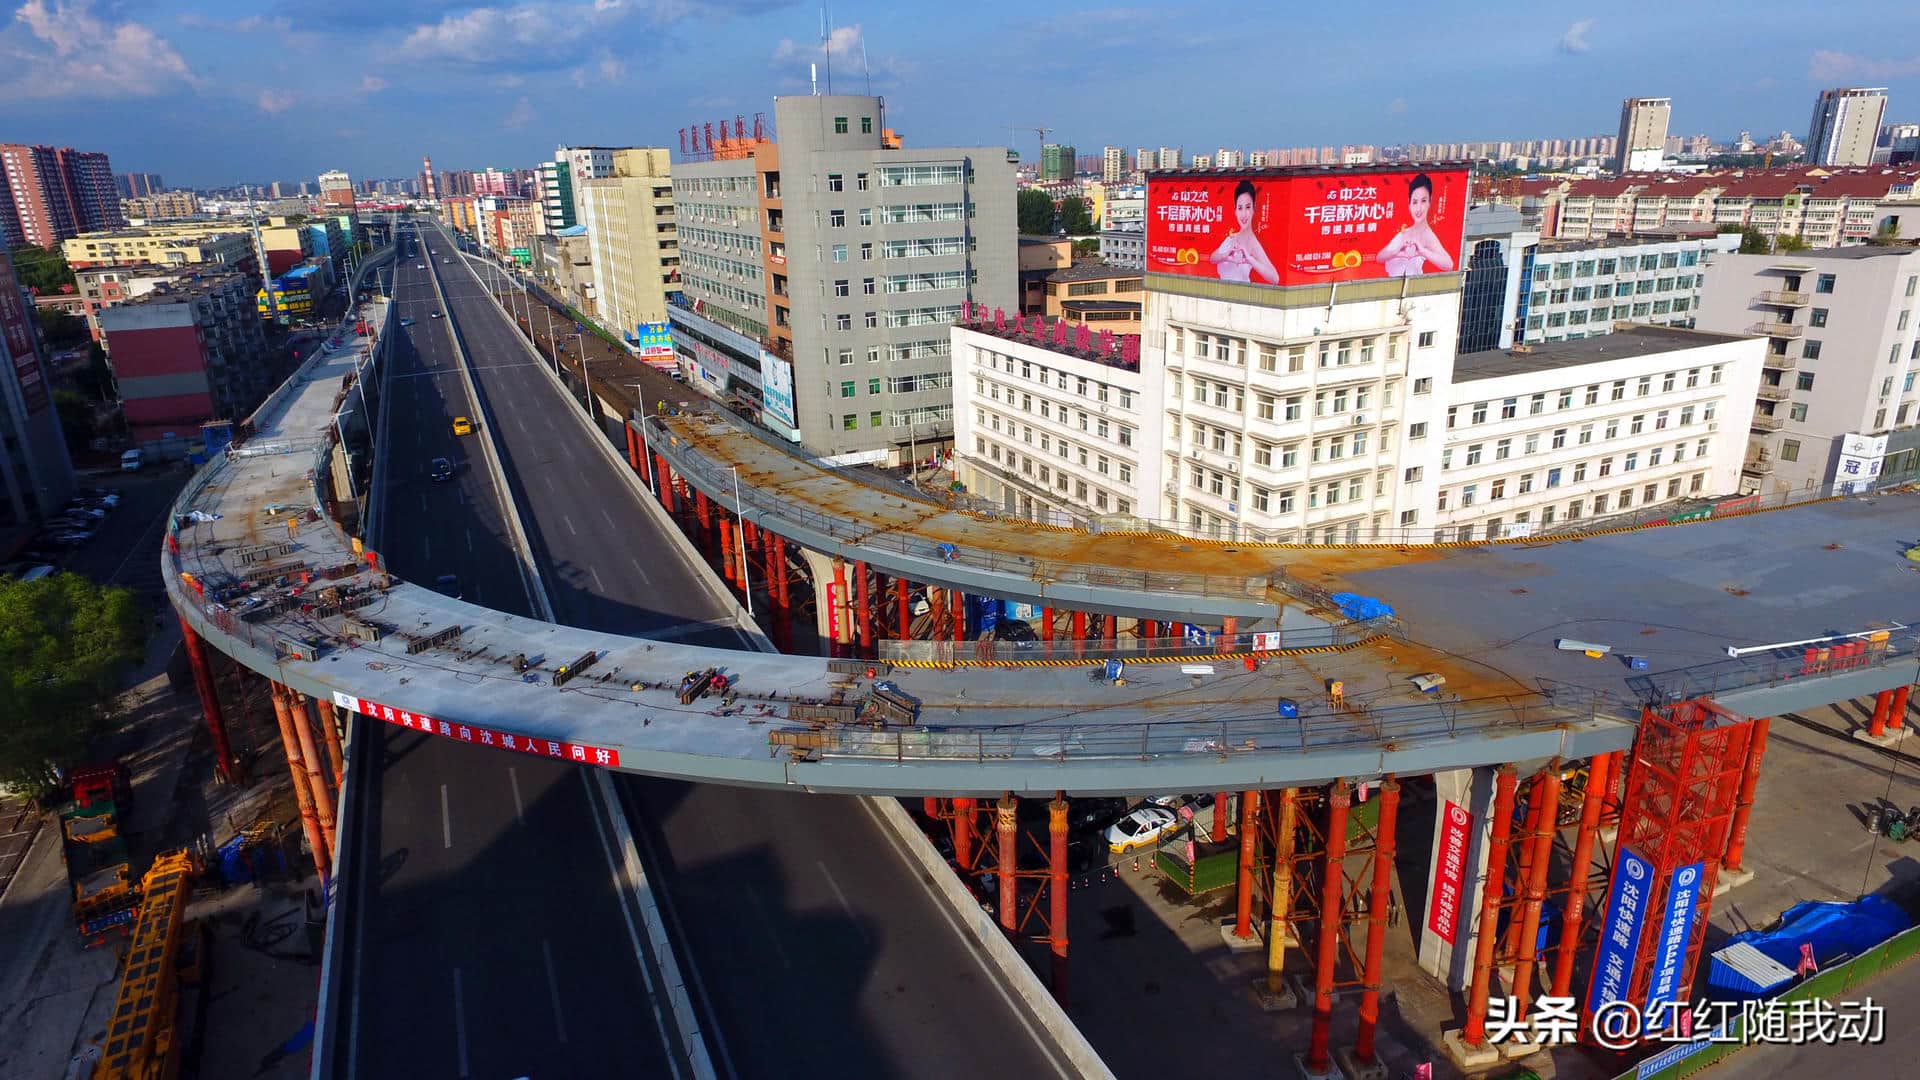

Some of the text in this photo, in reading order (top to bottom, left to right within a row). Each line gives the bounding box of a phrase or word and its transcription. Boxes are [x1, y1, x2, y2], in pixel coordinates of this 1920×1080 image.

[1304, 203, 1385, 224] 千层酥冰心
[1340, 187, 1377, 201] 中之杰
[366, 701, 611, 764] 沈阳快速路向沈城人民问好
[1612, 880, 1639, 949] 沈阳快速路
